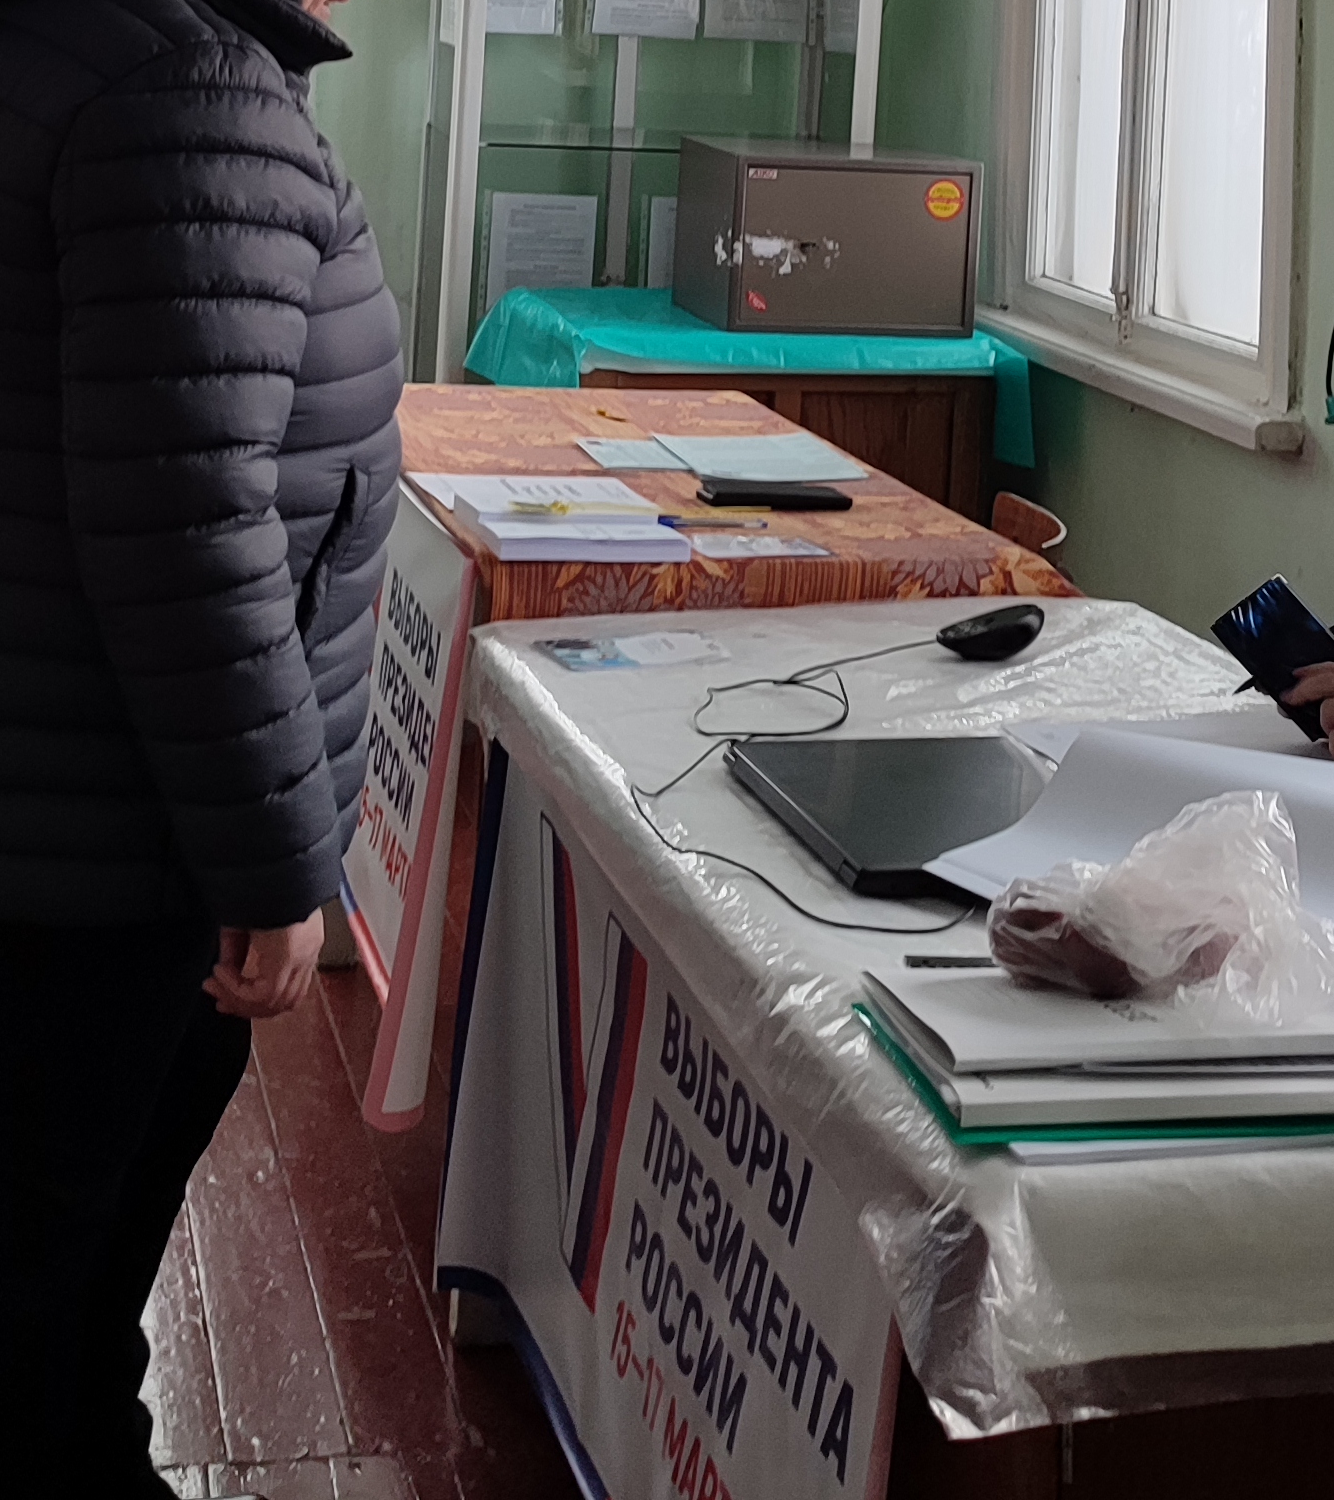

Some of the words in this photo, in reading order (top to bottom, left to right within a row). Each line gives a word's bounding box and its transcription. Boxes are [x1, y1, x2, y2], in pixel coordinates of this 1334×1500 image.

[387, 566, 442, 687] ВЫБОРЫ
[358, 785, 384, 853] 5-17
[367, 710, 416, 832] РОССИИ
[660, 990, 814, 1248] ВЫБОРЫ
[626, 1198, 749, 1457] РОССИИ
[643, 1096, 855, 1487] ПРЕЗИДЕНТА
[610, 1299, 666, 1434] 15-17
